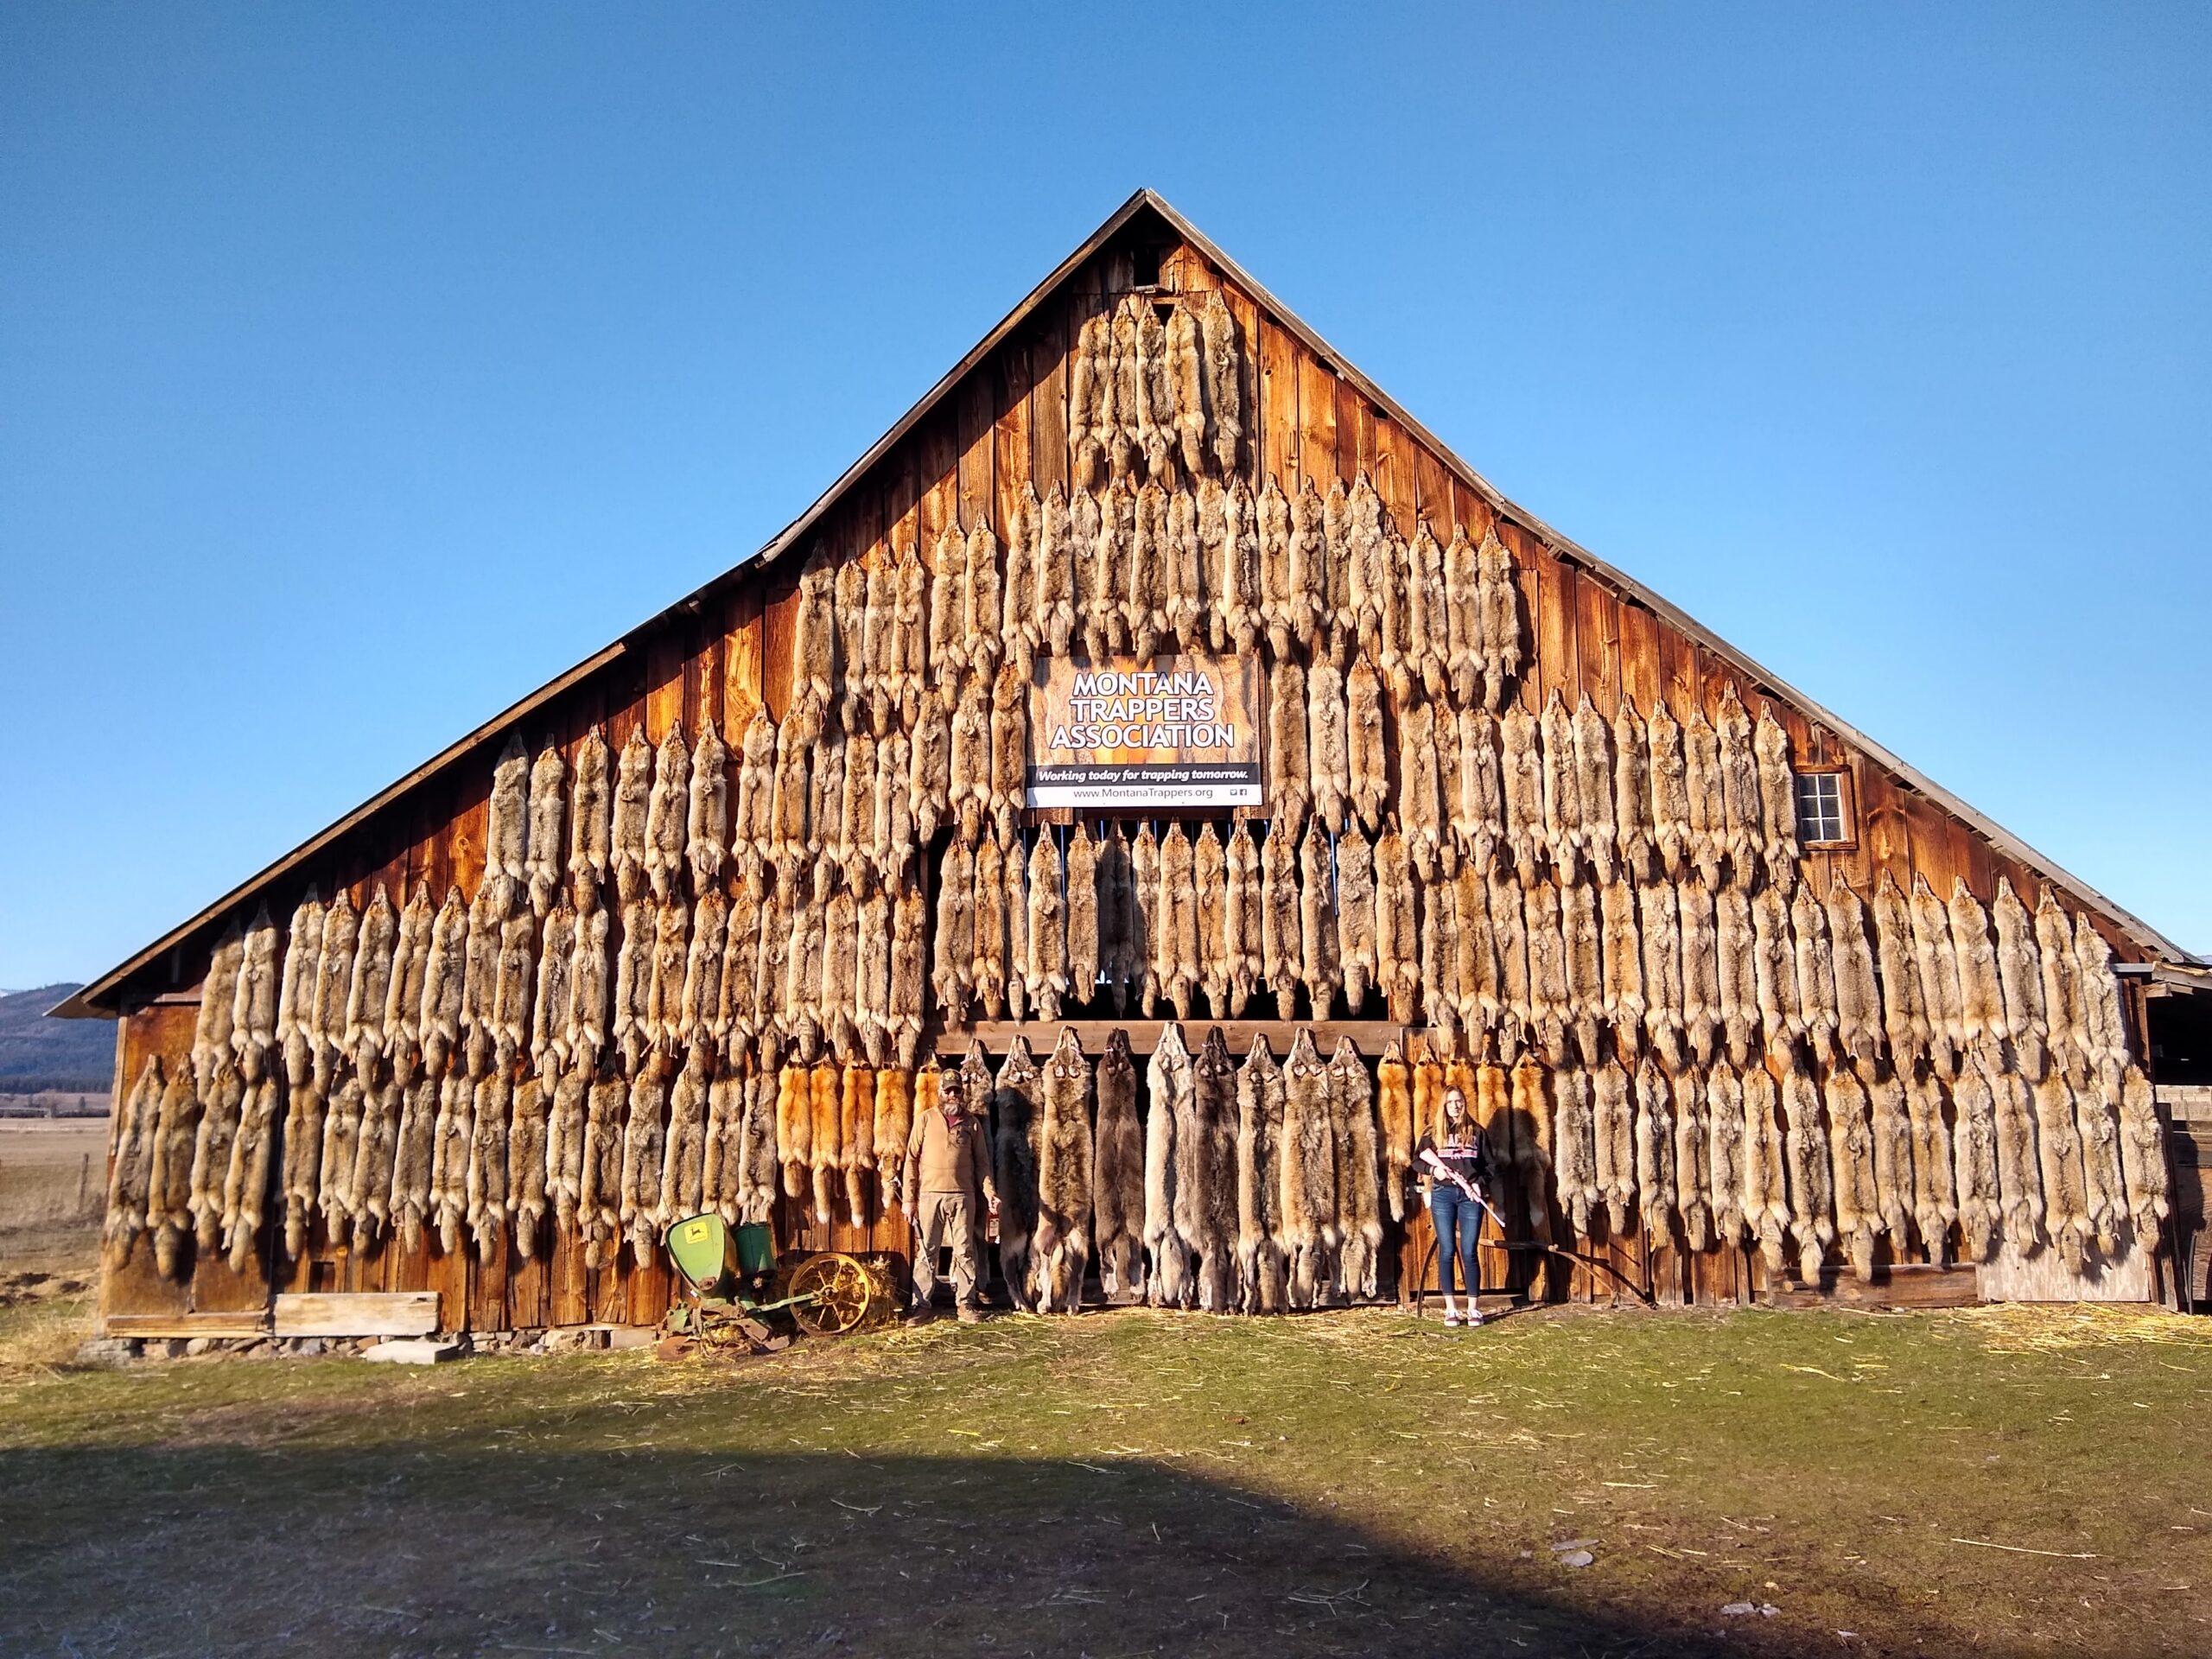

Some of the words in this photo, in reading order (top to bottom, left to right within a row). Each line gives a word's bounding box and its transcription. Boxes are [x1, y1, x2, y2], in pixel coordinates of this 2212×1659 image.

[1073, 671, 1214, 696] MONTANA
[1070, 698, 1215, 721] TRAPPERS
[1050, 724, 1234, 749] ASSOCIATION
[1039, 770, 1086, 783] Working
[1089, 770, 1121, 783] today
[1122, 769, 1140, 782] for
[1141, 769, 1190, 782] trapping
[1192, 770, 1249, 779] tomorrow.
[1073, 788, 1213, 799] www.MontanaTrappers.org
